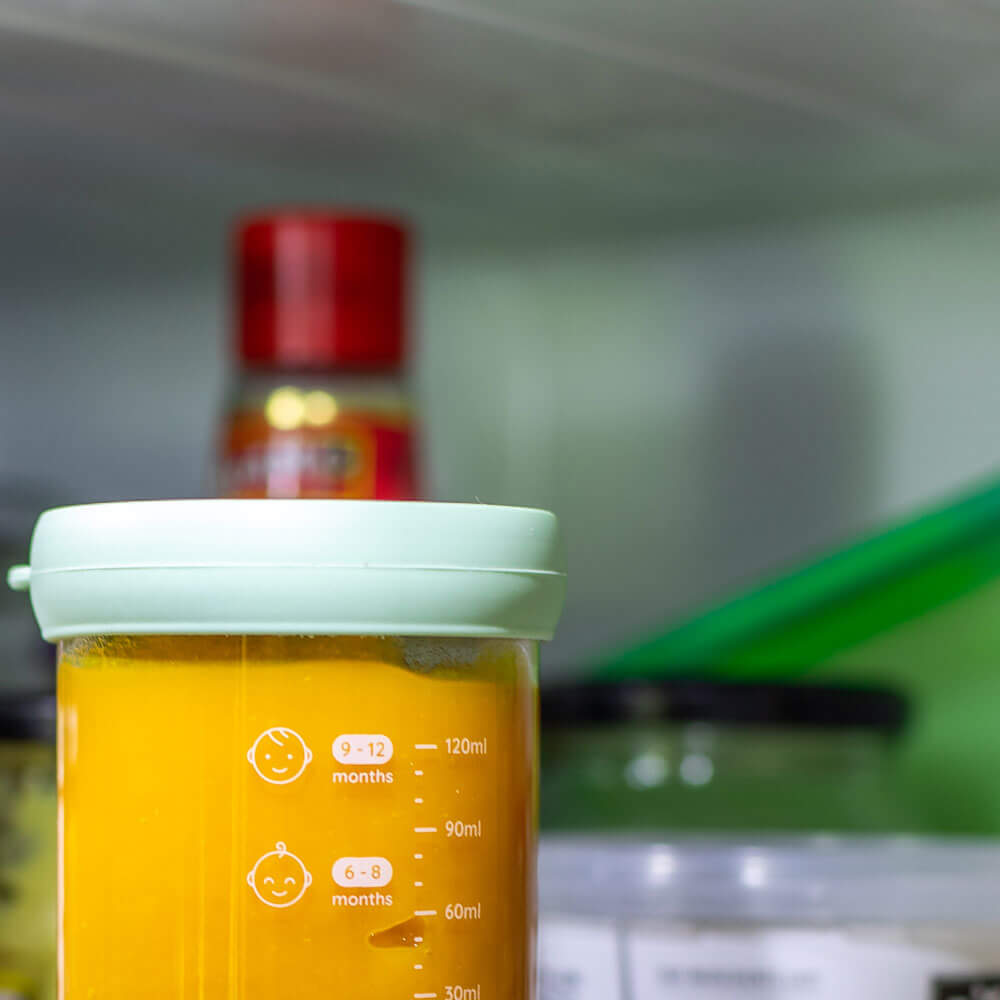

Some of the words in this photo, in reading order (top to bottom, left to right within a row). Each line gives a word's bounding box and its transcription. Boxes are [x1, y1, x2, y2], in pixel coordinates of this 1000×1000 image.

[340, 742, 351, 757] 9
[368, 742, 385, 757] 12
[445, 738, 487, 755] 120ml
[332, 770, 394, 784] months
[445, 820, 481, 837] 90ml
[344, 865, 354, 879] 6
[371, 865, 381, 879] 8
[332, 892, 393, 907] months
[445, 903, 481, 920] 60ml
